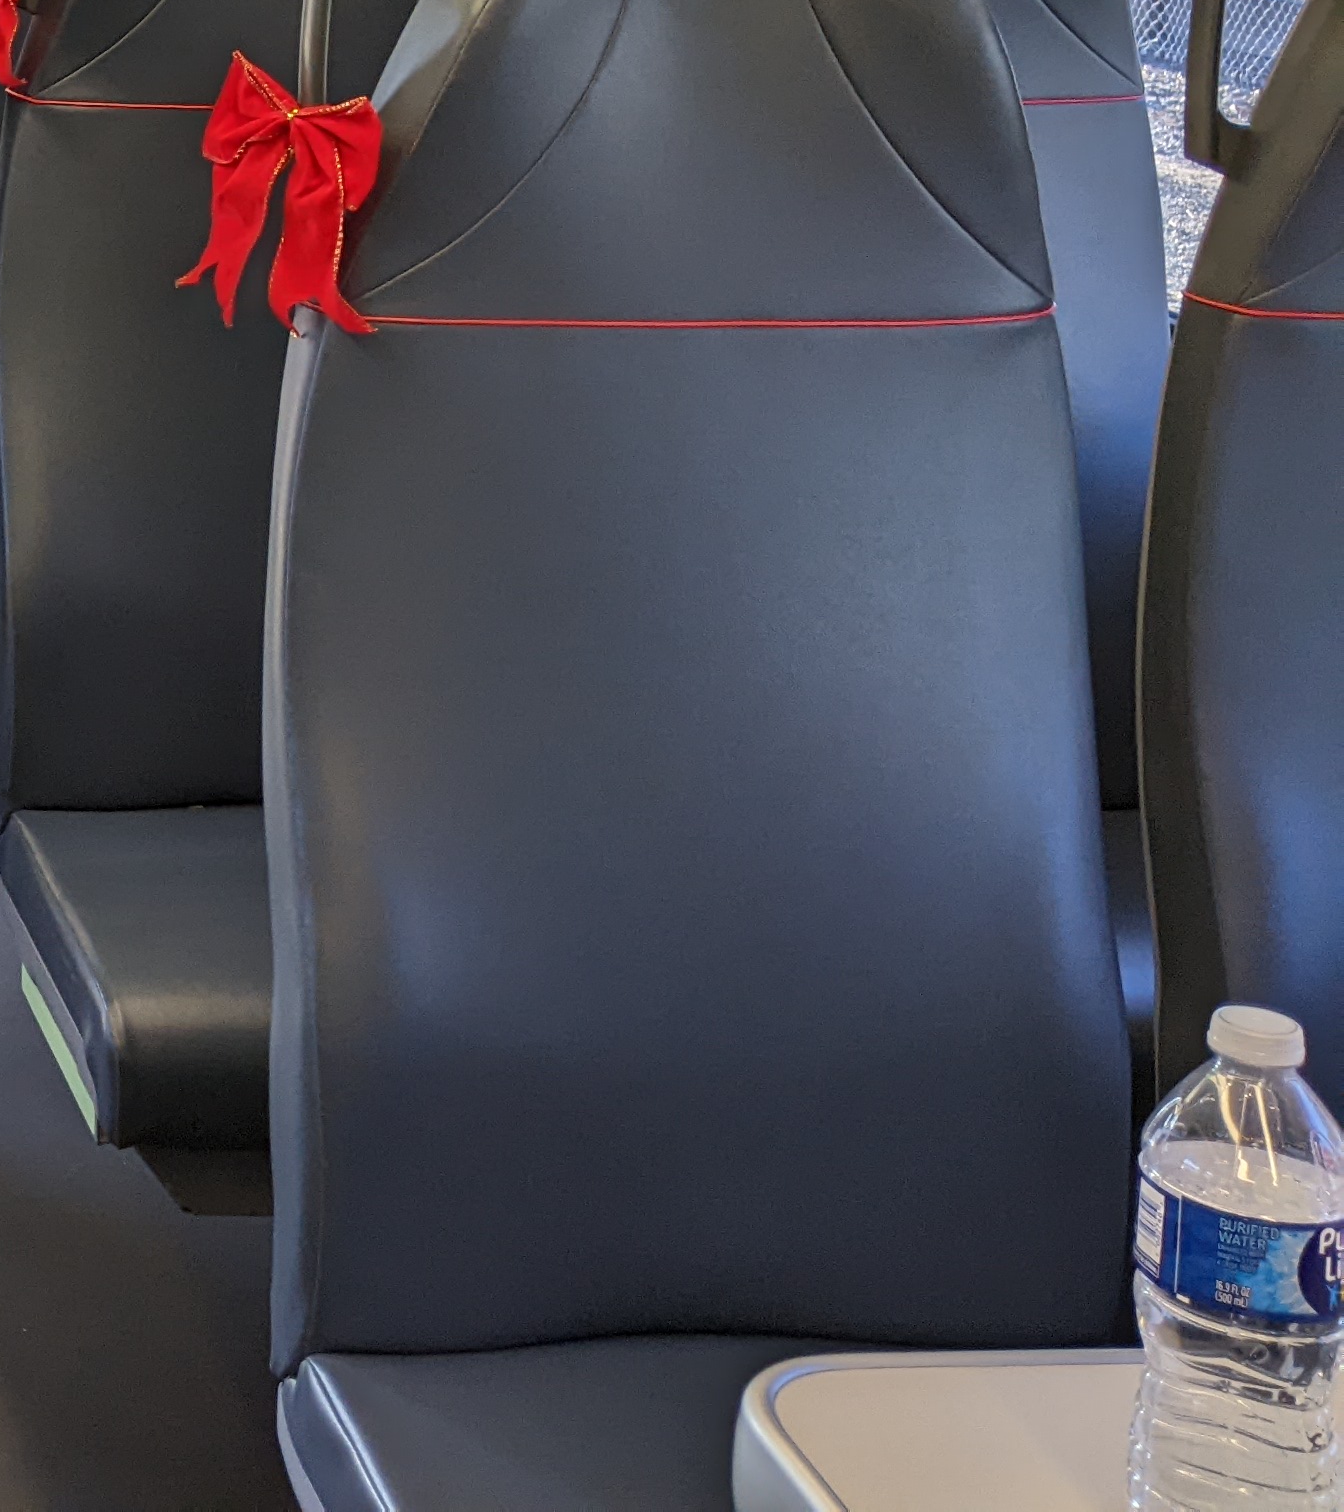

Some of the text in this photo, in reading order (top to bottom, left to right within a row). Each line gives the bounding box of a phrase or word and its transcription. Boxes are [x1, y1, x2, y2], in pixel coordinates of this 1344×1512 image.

[1218, 1217, 1280, 1240] PURIFIED
[1218, 1230, 1267, 1250] WATER
[1215, 1279, 1230, 1293] 16.9
[1214, 1291, 1233, 1304] (500
